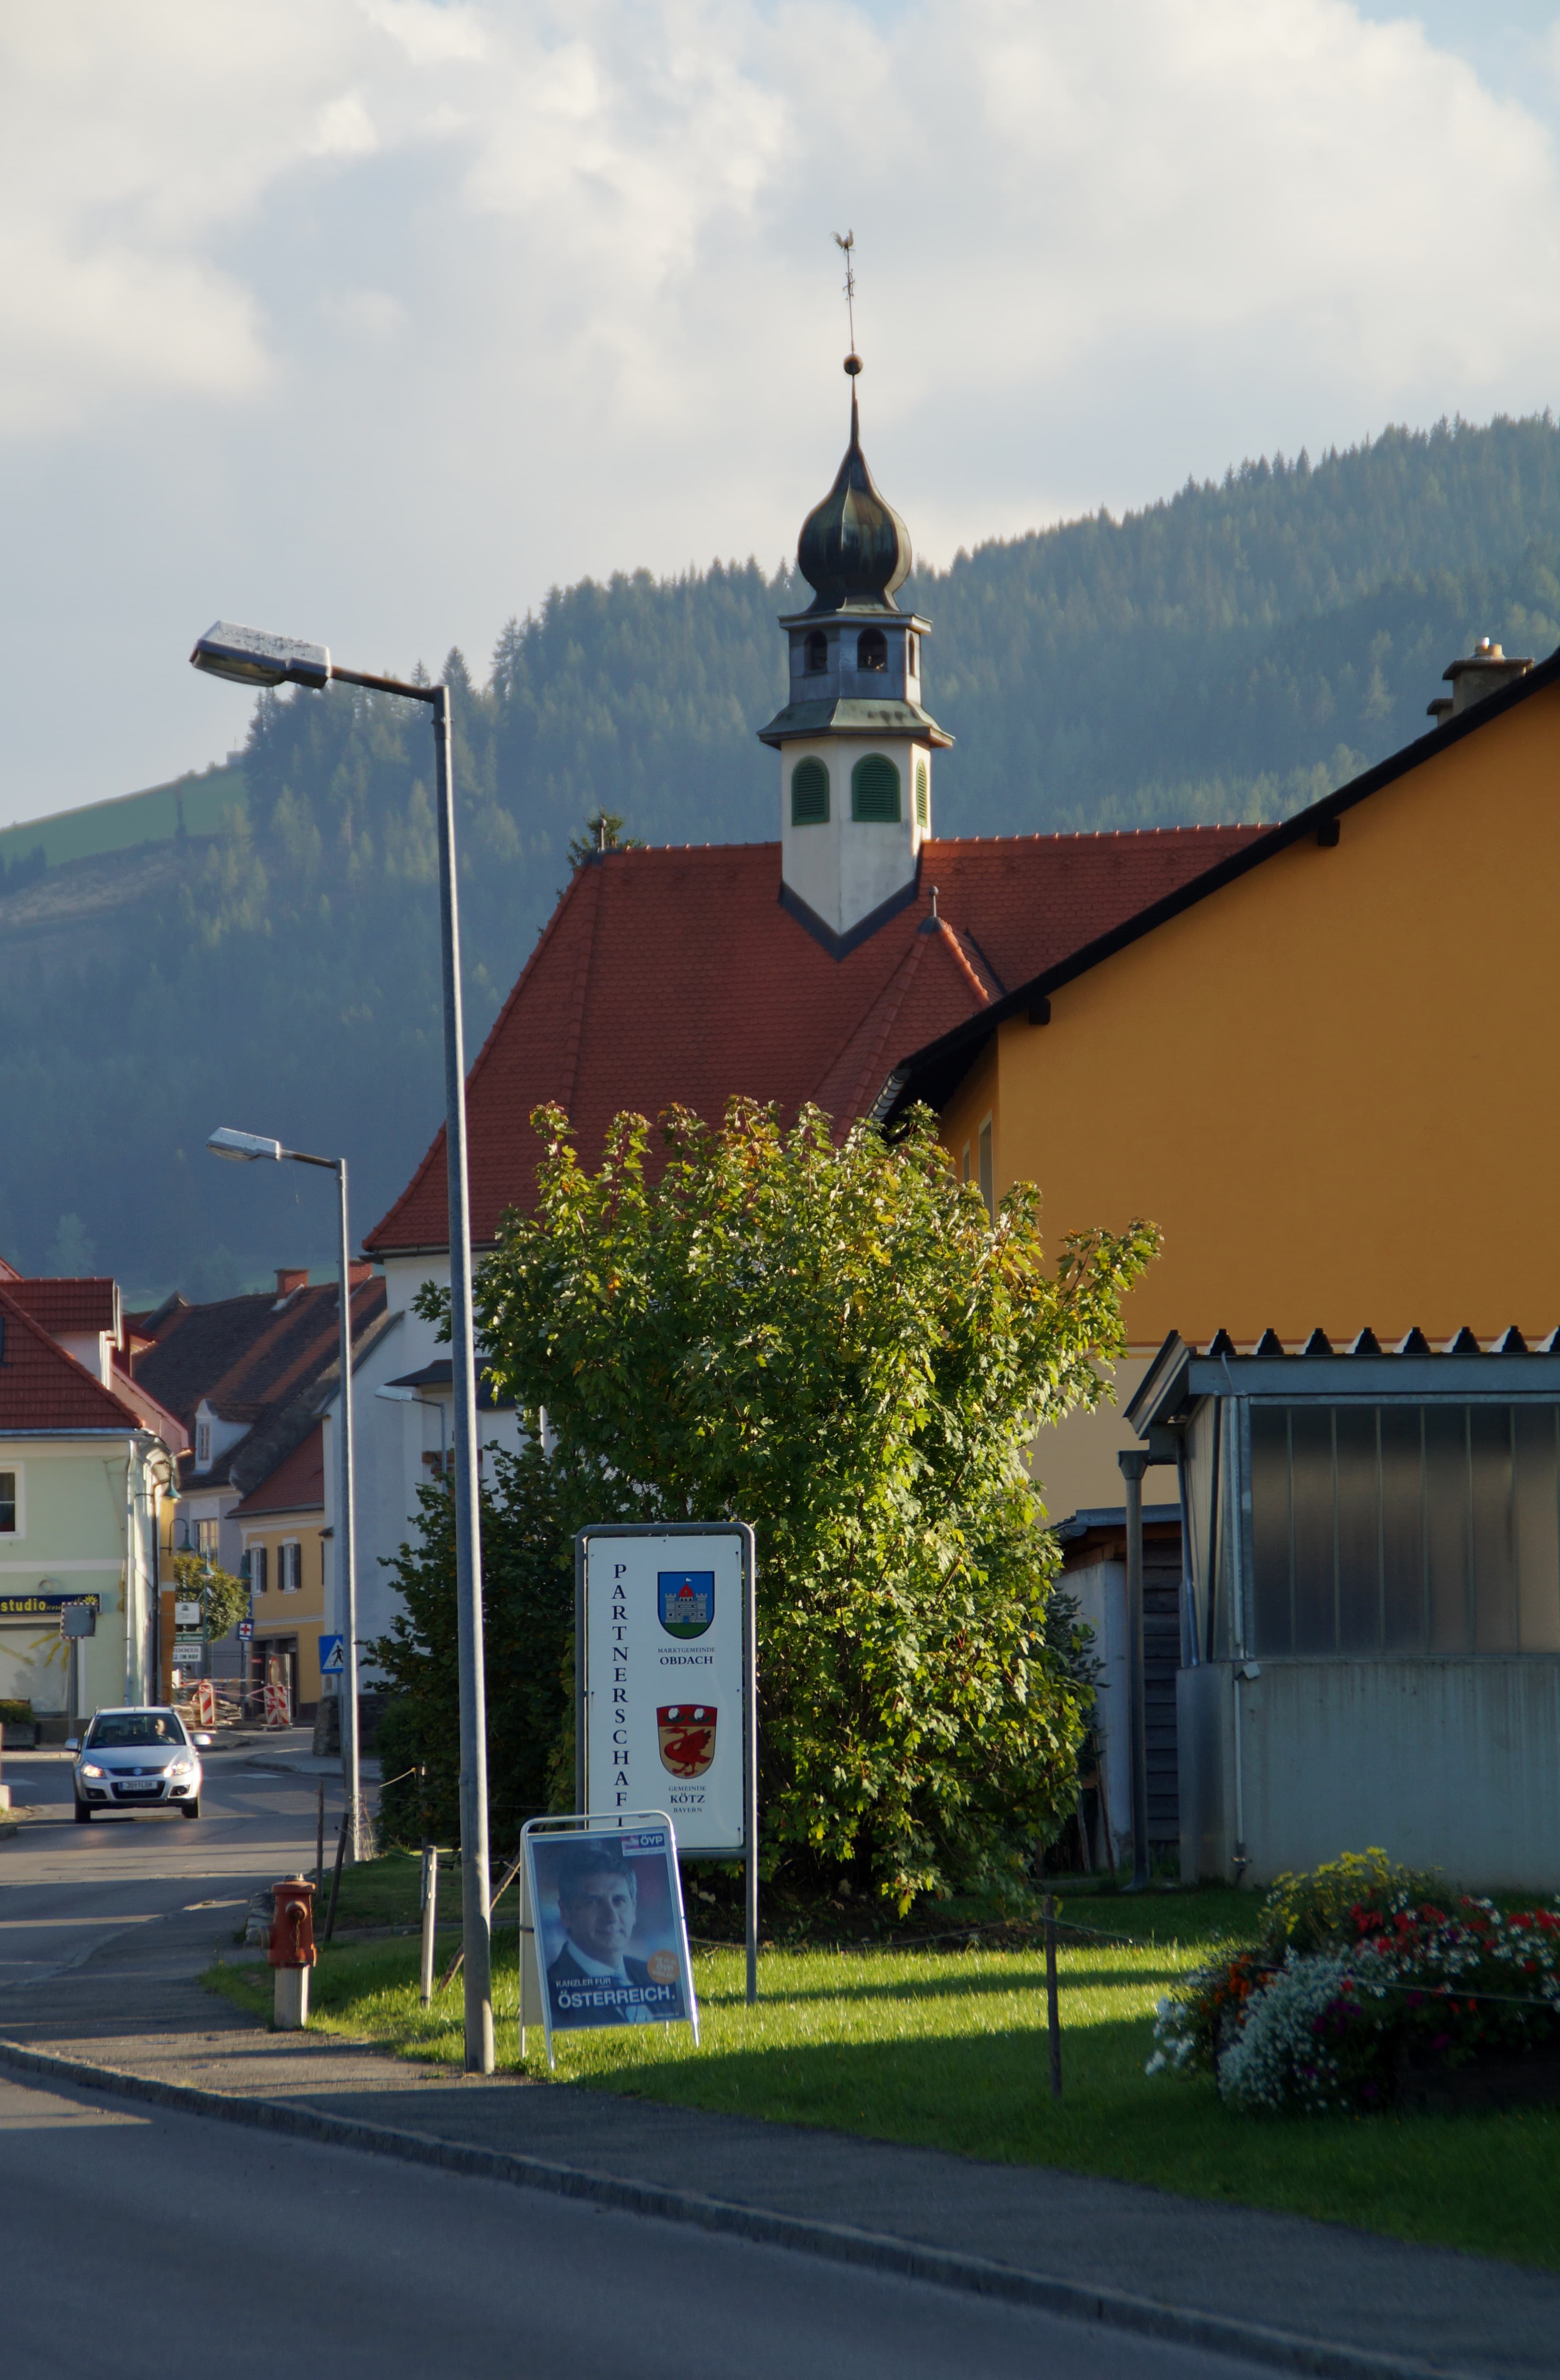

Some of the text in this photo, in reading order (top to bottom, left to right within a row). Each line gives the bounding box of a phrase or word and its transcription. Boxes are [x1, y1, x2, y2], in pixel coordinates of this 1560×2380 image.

[1, 1598, 46, 1612] studio
[660, 1656, 713, 1665] OBDACH
[670, 1793, 705, 1803] KÖTZ
[640, 1835, 663, 1846] ÖVP
[556, 1978, 593, 1988] KANZLER
[558, 1986, 676, 2008] ÖSTERREICH.
